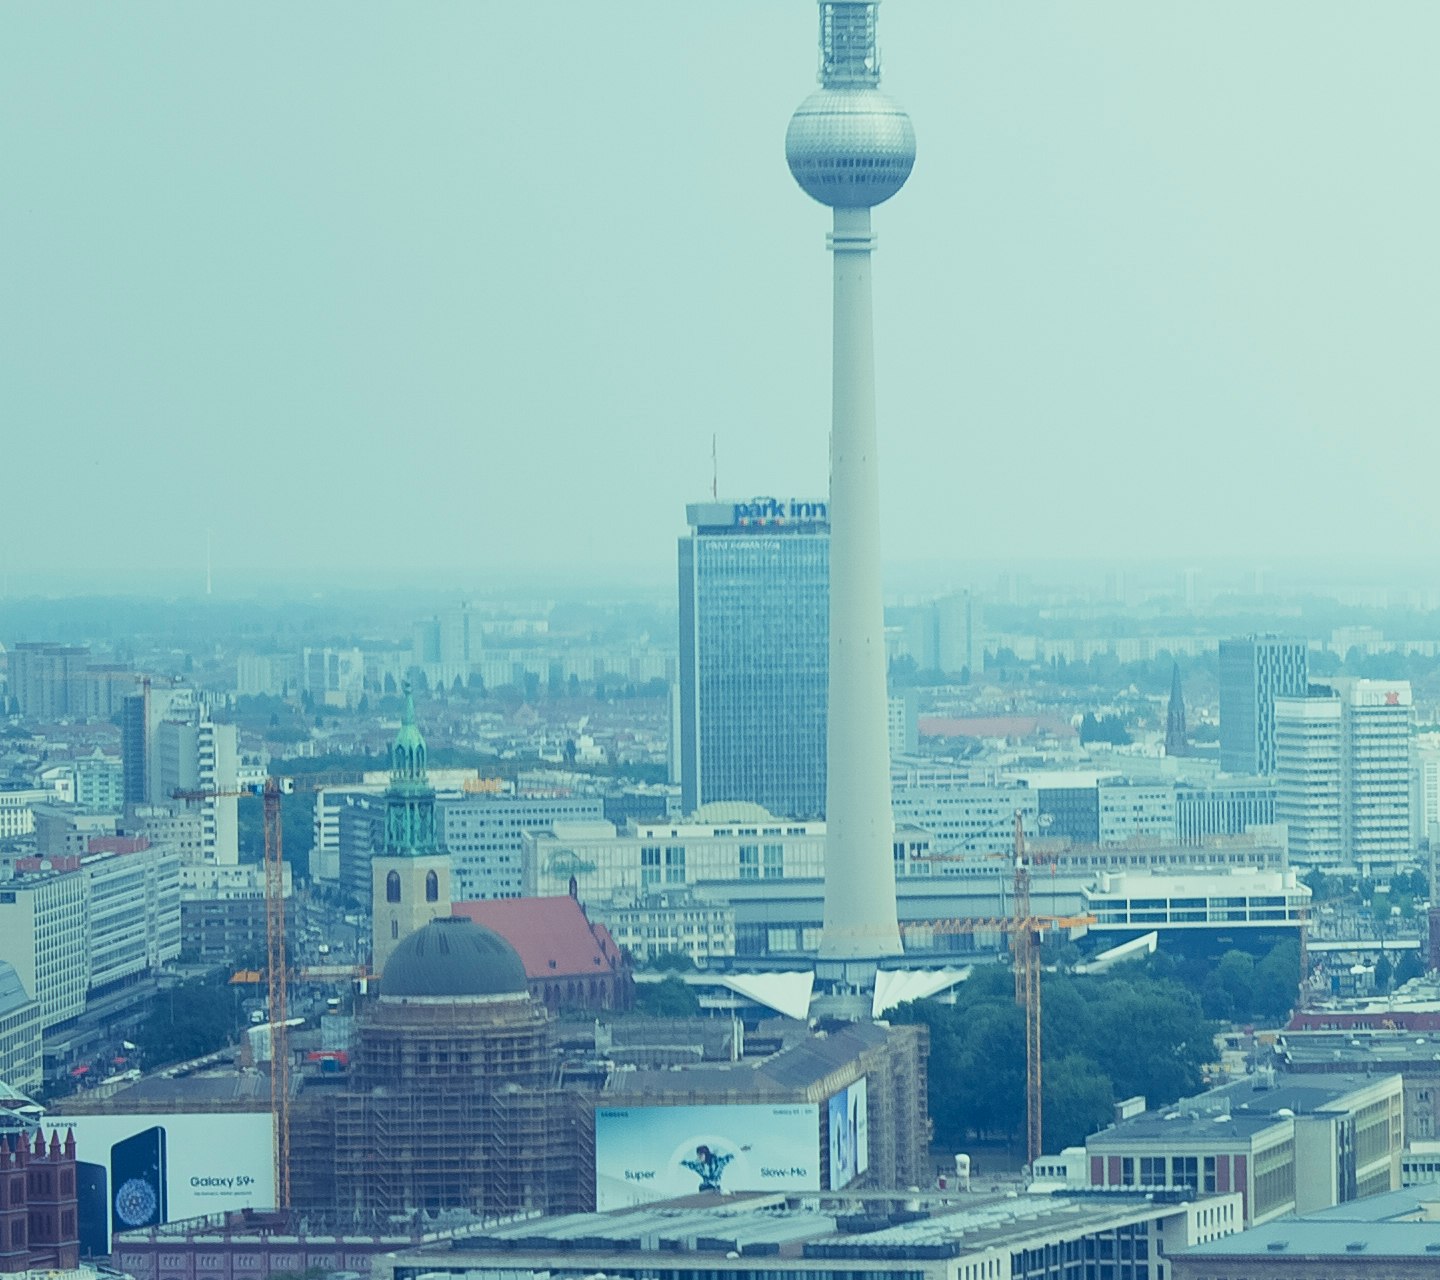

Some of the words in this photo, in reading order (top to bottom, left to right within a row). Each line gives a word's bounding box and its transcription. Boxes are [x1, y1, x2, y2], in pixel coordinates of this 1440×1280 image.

[735, 498, 785, 524] park
[790, 498, 826, 518] inn
[190, 1176, 233, 1188] Galaxy
[236, 1176, 255, 1186] S9+
[624, 1168, 656, 1182] Super
[760, 1166, 807, 1178] Slow-Mo
